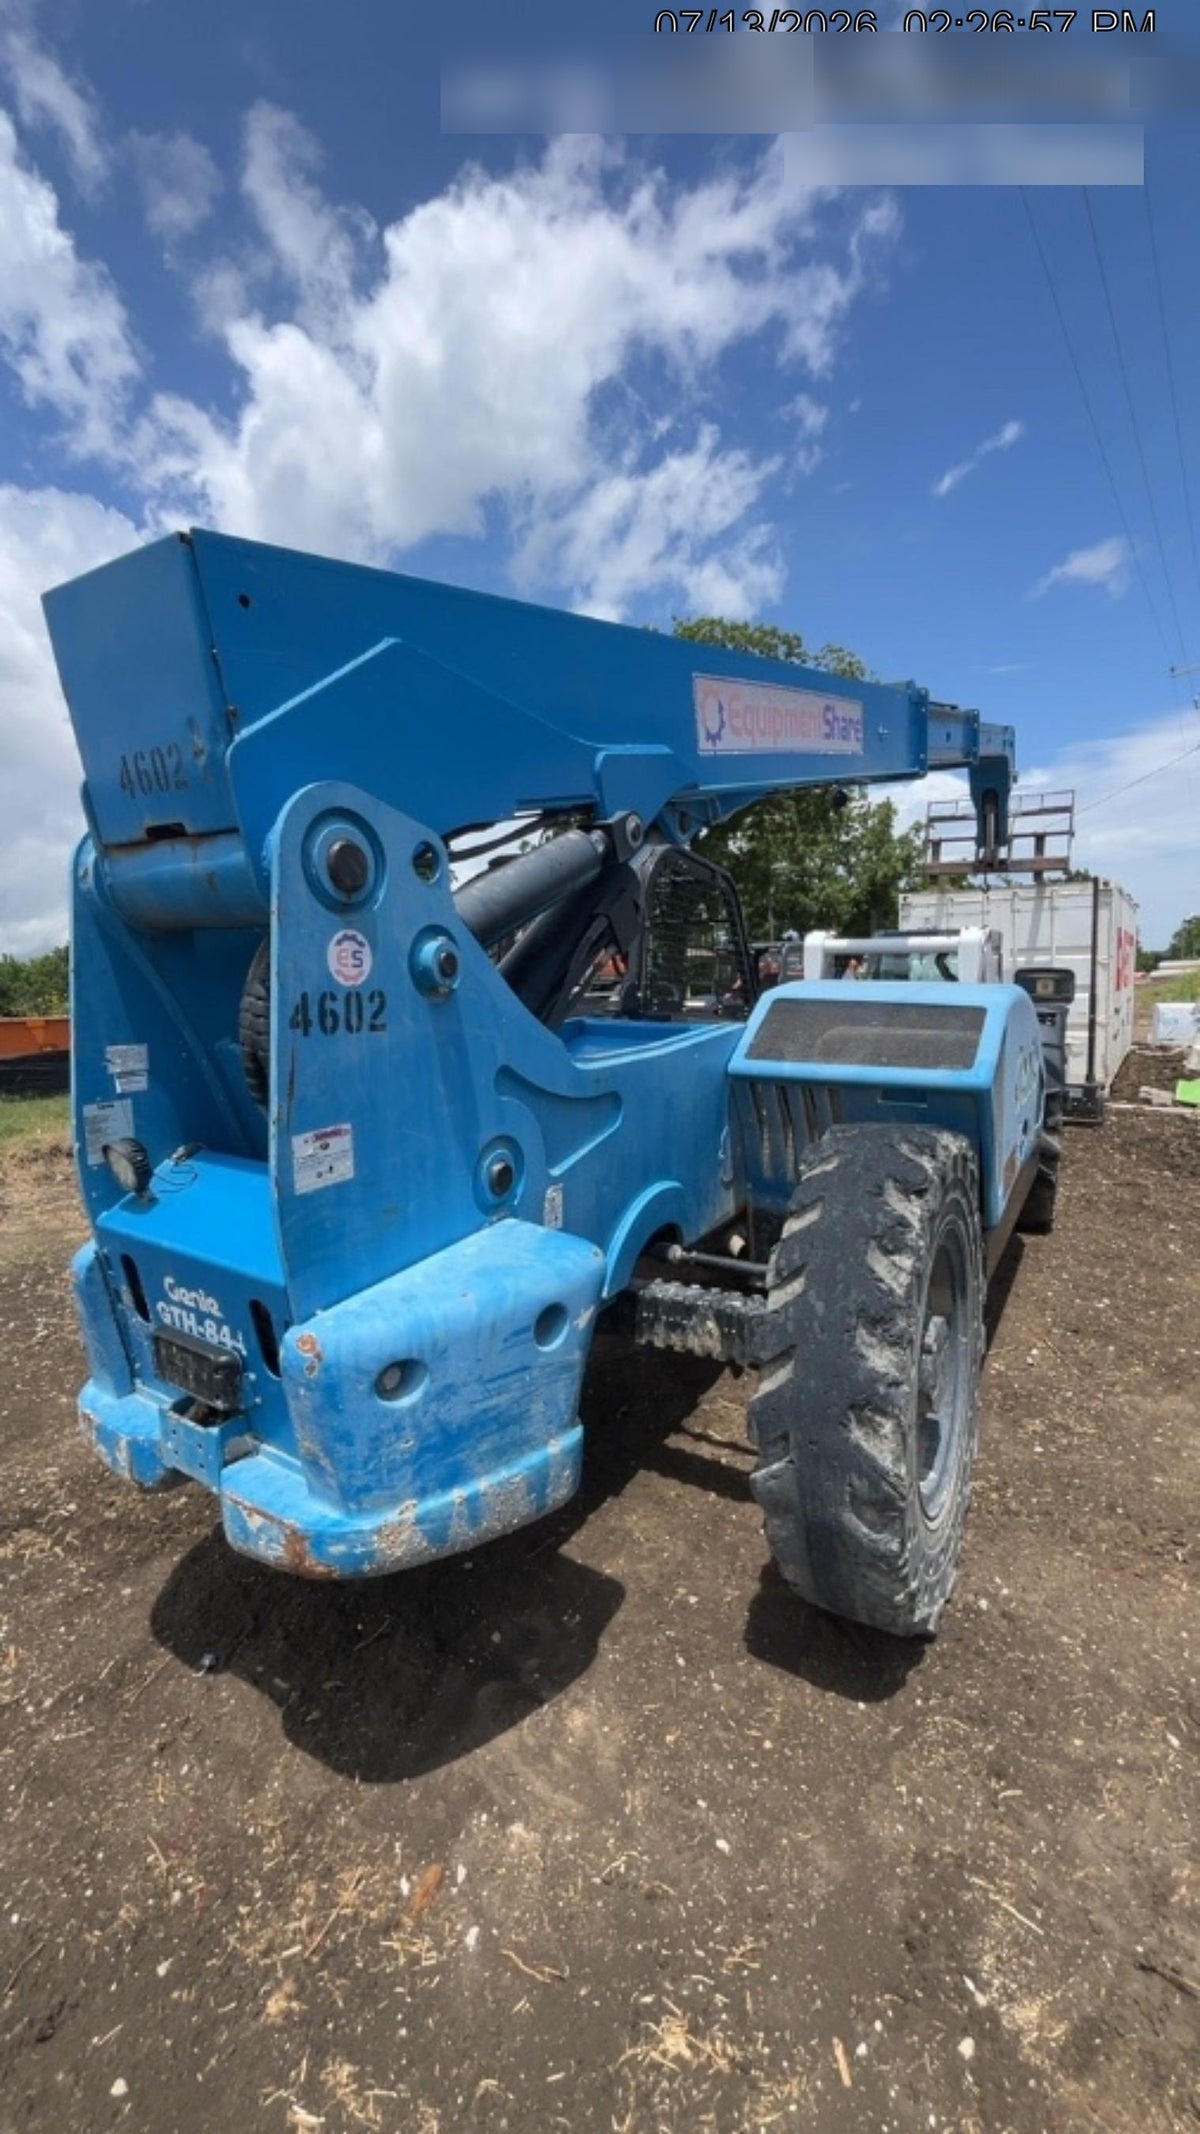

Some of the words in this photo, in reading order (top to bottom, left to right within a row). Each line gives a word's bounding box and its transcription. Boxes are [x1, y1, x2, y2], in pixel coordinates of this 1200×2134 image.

[728, 691, 861, 744] EquipmentShare
[120, 742, 189, 799] 4602
[336, 948, 364, 968] ES
[289, 990, 387, 1037] 4602
[163, 1276, 224, 1319] Genie
